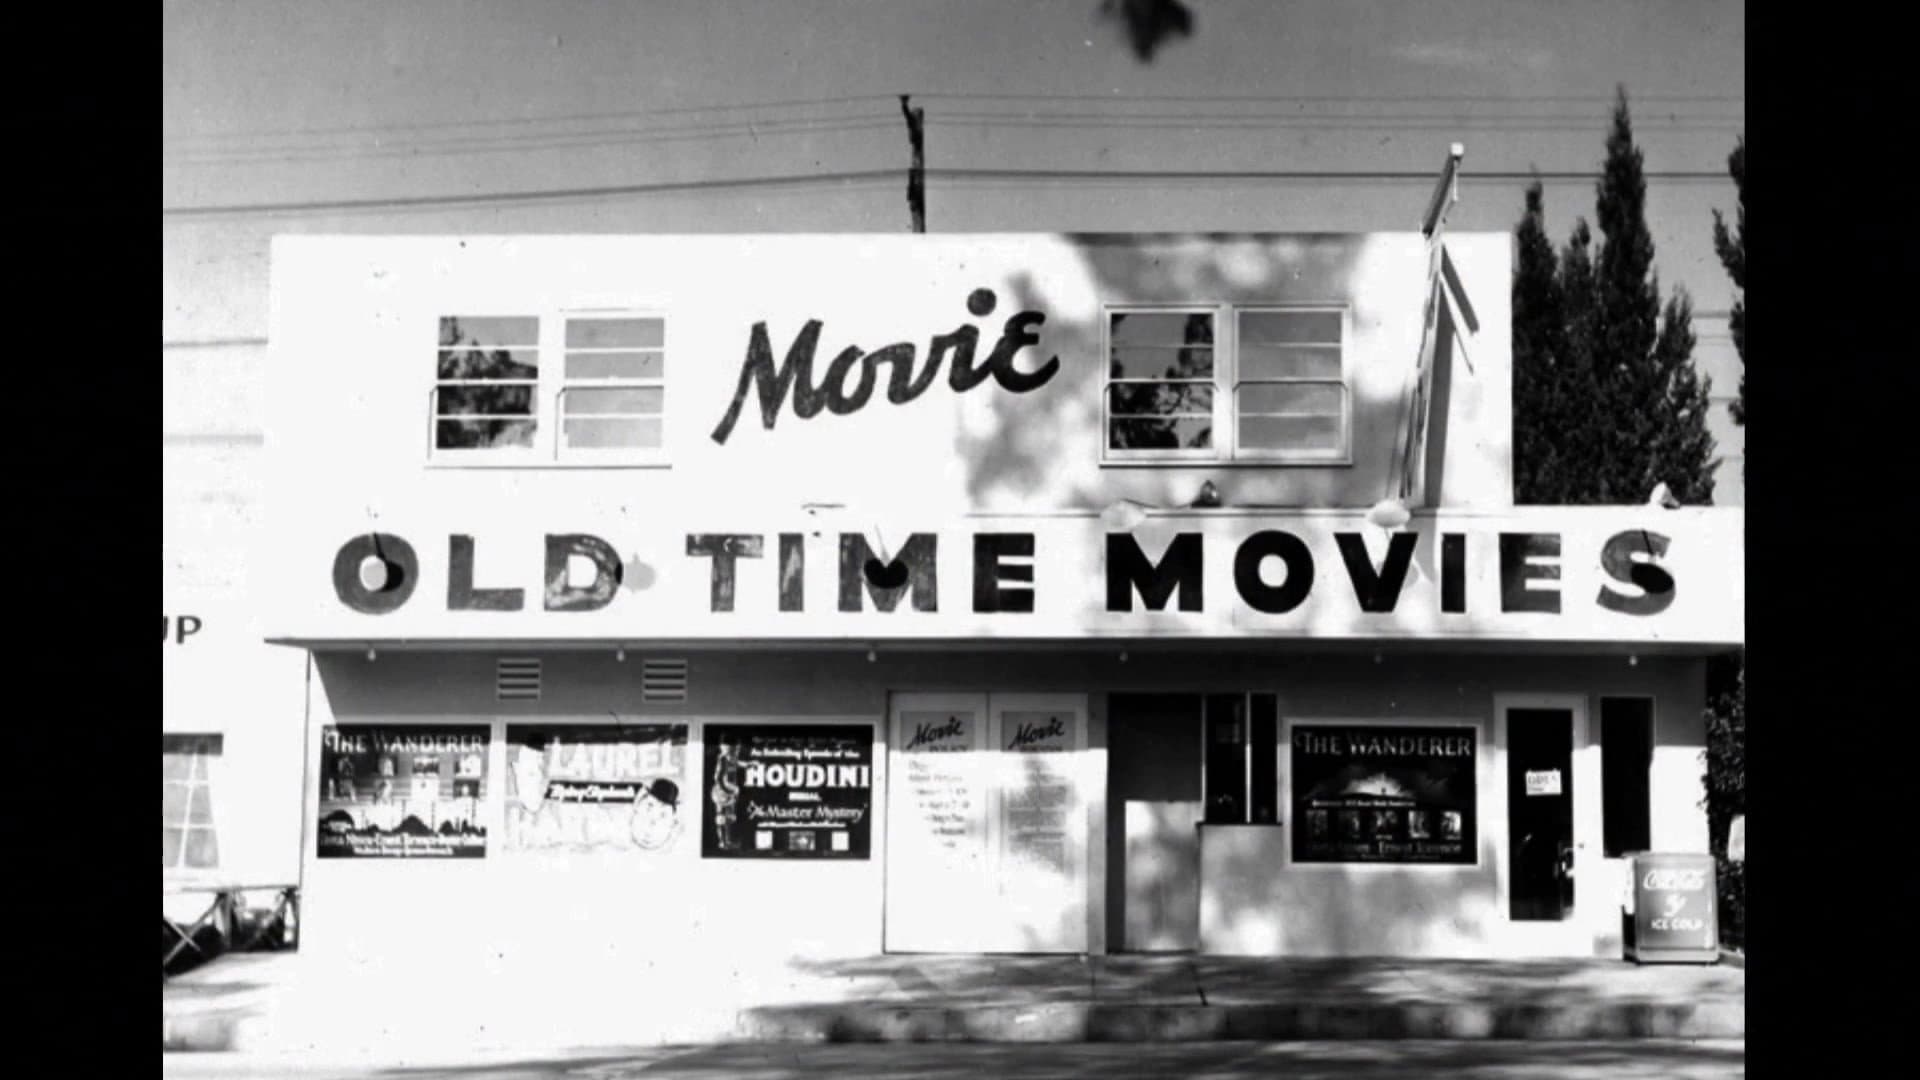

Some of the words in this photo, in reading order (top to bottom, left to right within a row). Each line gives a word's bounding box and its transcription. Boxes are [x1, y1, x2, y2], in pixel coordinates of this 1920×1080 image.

[711, 287, 1060, 446] Movie
[333, 533, 623, 615] OLD
[686, 532, 1036, 613] TIME
[1105, 529, 1676, 616] MOVIES
[163, 615, 202, 645] P
[324, 729, 368, 753] THE
[373, 729, 483, 753] WANDERER
[1295, 731, 1342, 755] THE
[1347, 731, 1472, 756] WANDERER
[548, 736, 679, 778] LAUREL
[744, 763, 869, 788] HOUDINI
